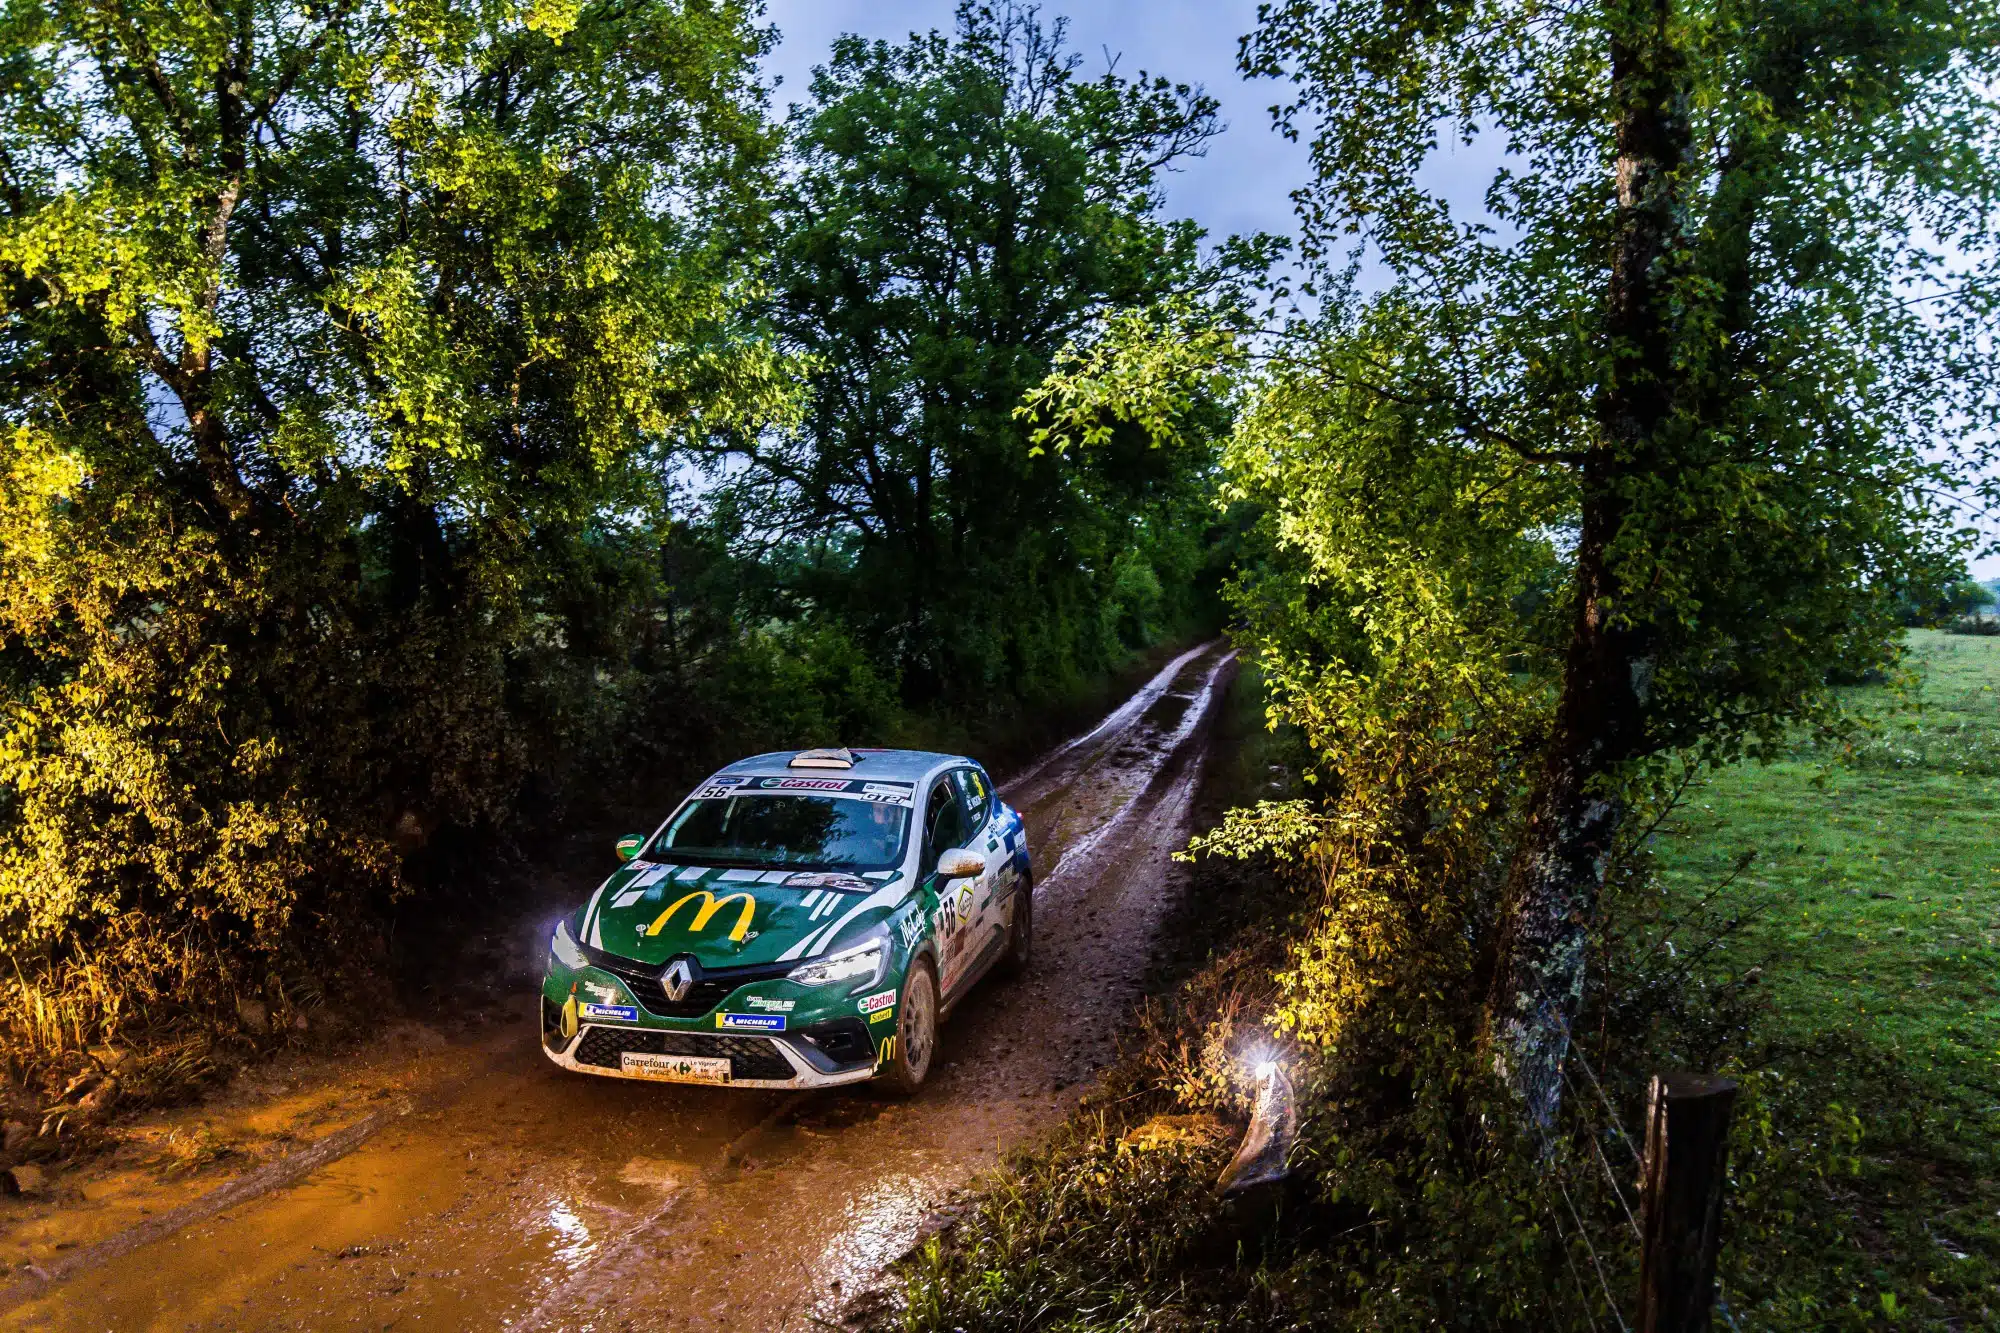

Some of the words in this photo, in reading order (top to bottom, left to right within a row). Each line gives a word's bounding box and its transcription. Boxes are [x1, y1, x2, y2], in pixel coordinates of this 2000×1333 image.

[781, 779, 846, 789] Castrol
[701, 787, 730, 798] 56
[944, 897, 956, 939] 56
[869, 991, 895, 1010] Castrol
[596, 1008, 631, 1017] MICHELIN
[623, 1056, 669, 1069] Carrefour
